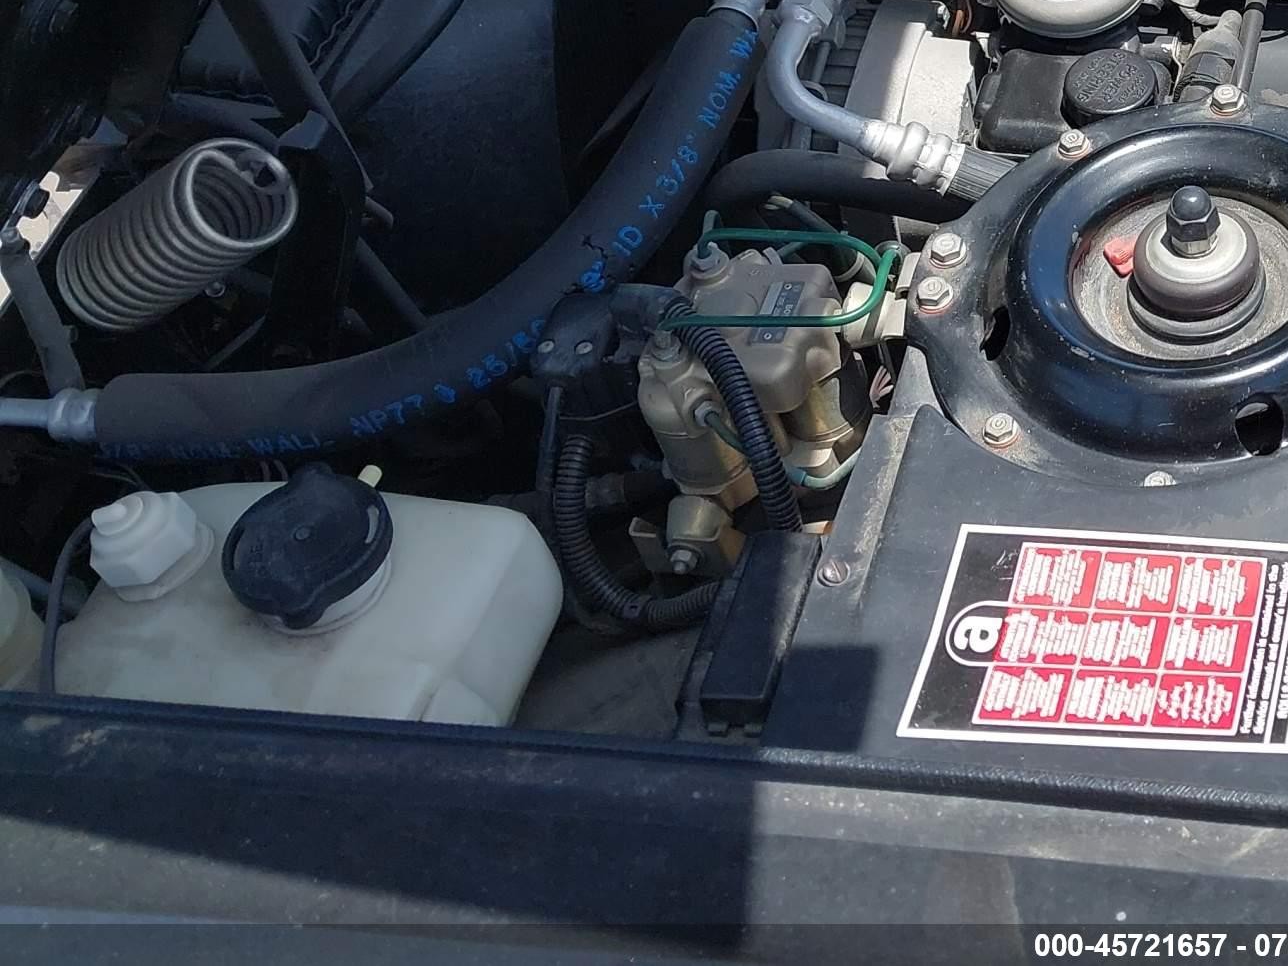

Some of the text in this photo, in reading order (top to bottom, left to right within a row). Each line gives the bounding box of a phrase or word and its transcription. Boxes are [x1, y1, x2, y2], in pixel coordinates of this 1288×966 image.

[1076, 51, 1126, 102] STEERING
[639, 194, 665, 218] X
[1268, 564, 1279, 581] the
[1260, 594, 1276, 638] contained
[1271, 608, 1286, 643] owner's
[1268, 643, 1280, 662] and
[1247, 647, 1266, 701] information
[1261, 661, 1276, 700] manuals
[1239, 699, 1256, 735] Further
[1252, 700, 1270, 735] Service
